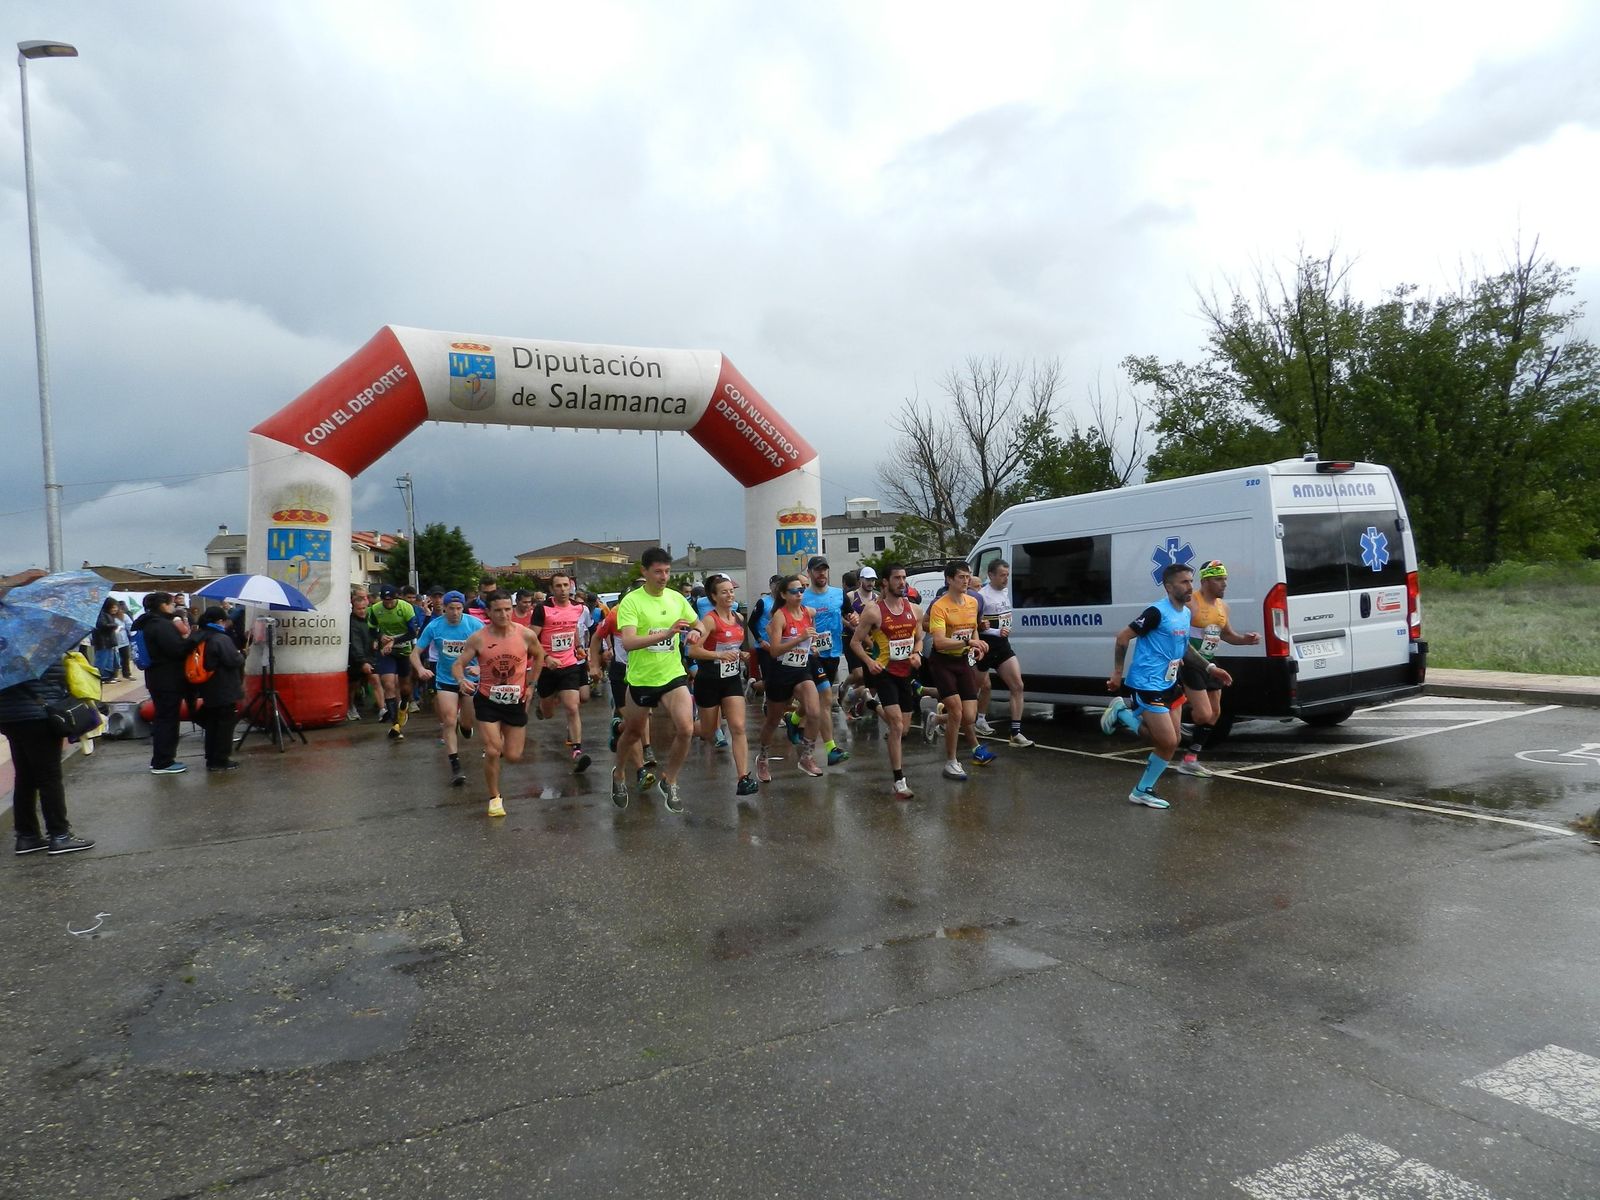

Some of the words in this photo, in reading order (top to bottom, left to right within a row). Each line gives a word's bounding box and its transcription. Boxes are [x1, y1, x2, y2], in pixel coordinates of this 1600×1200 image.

[512, 347, 662, 378] Diputación
[304, 419, 337, 446] CON
[332, 409, 353, 426] EL
[348, 364, 408, 414] DEPORTE
[512, 386, 537, 407] de
[549, 383, 687, 414] Salamanca
[724, 383, 748, 409] CON
[746, 405, 799, 460] NUESTROS
[715, 399, 785, 468] DEPORTISTAS
[1245, 478, 1261, 487] 520
[1292, 483, 1377, 498] AMBULANCIA
[1021, 613, 1103, 627] AMBULANCIA
[1303, 613, 1335, 622] DUCATO
[276, 632, 342, 646] alamanca
[787, 653, 805, 662] 219
[895, 645, 911, 656] 373
[495, 692, 514, 701] 341
